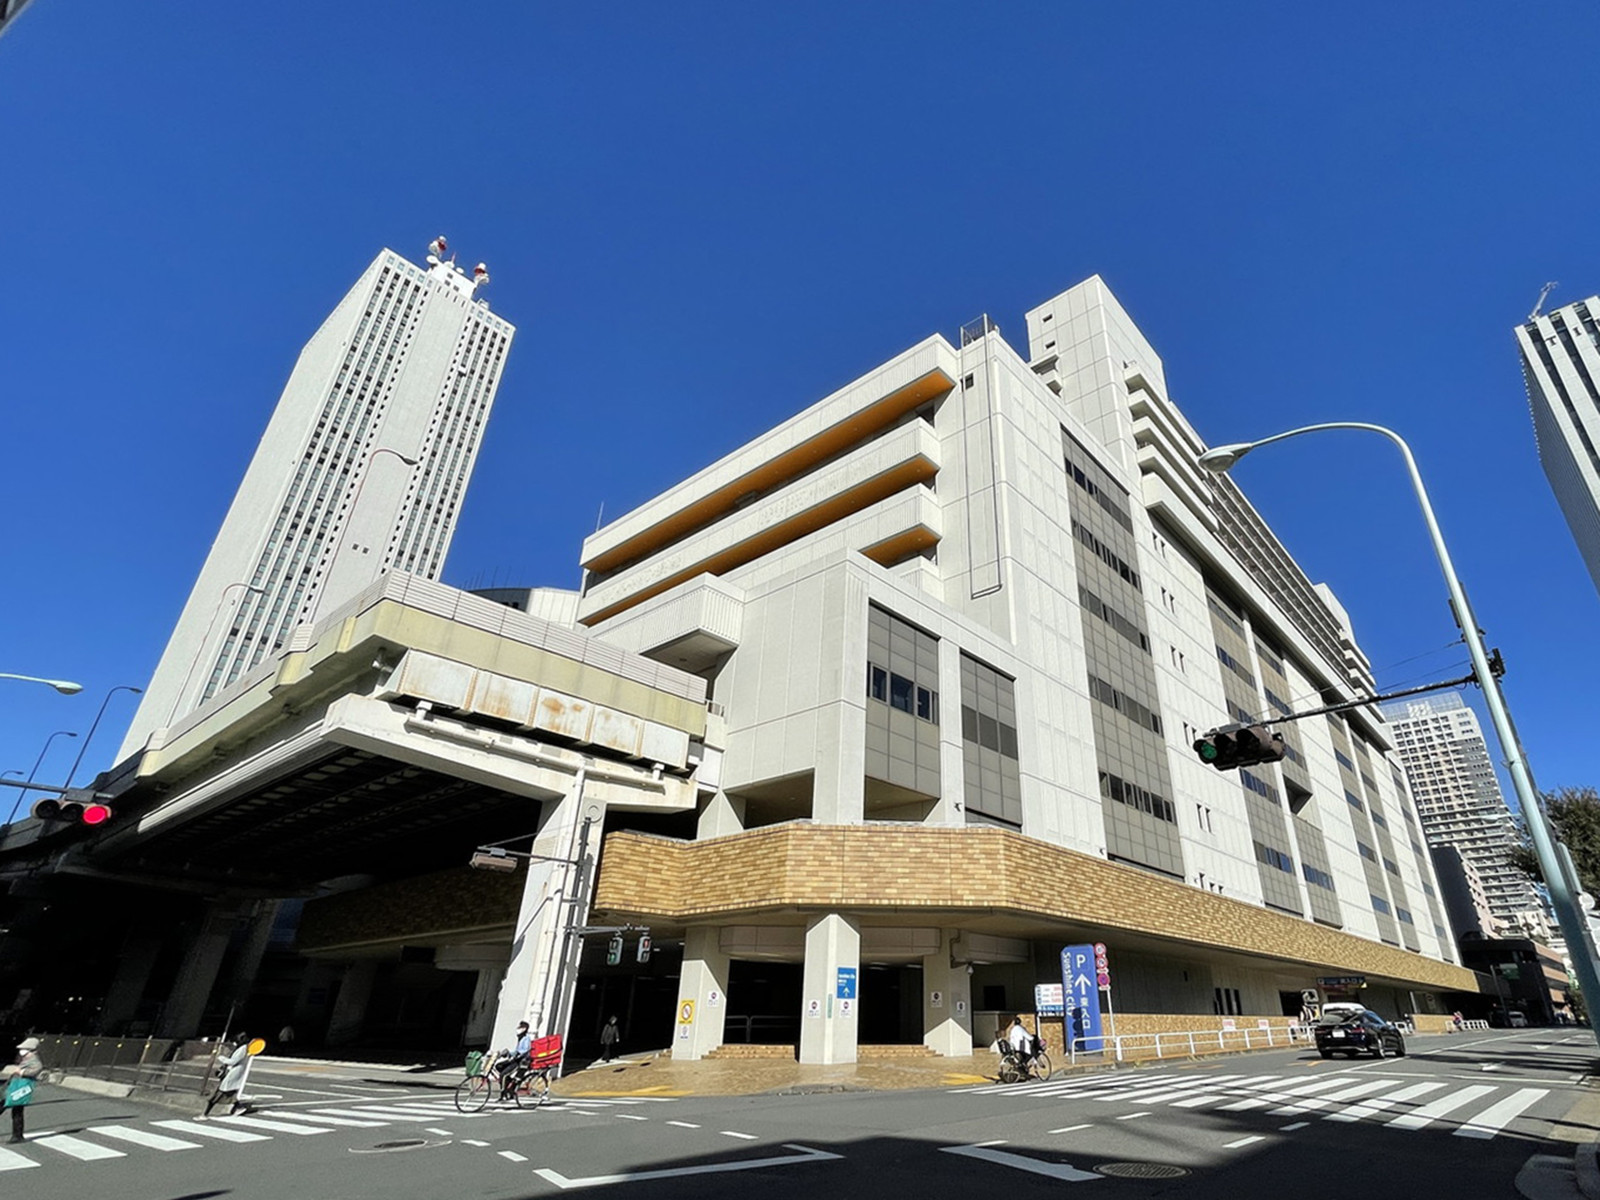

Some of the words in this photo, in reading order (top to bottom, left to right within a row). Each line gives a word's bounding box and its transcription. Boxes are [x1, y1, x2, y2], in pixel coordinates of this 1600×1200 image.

[1076, 954, 1086, 969] P
[1063, 952, 1073, 995] Sunshine
[1066, 996, 1076, 1016] City
